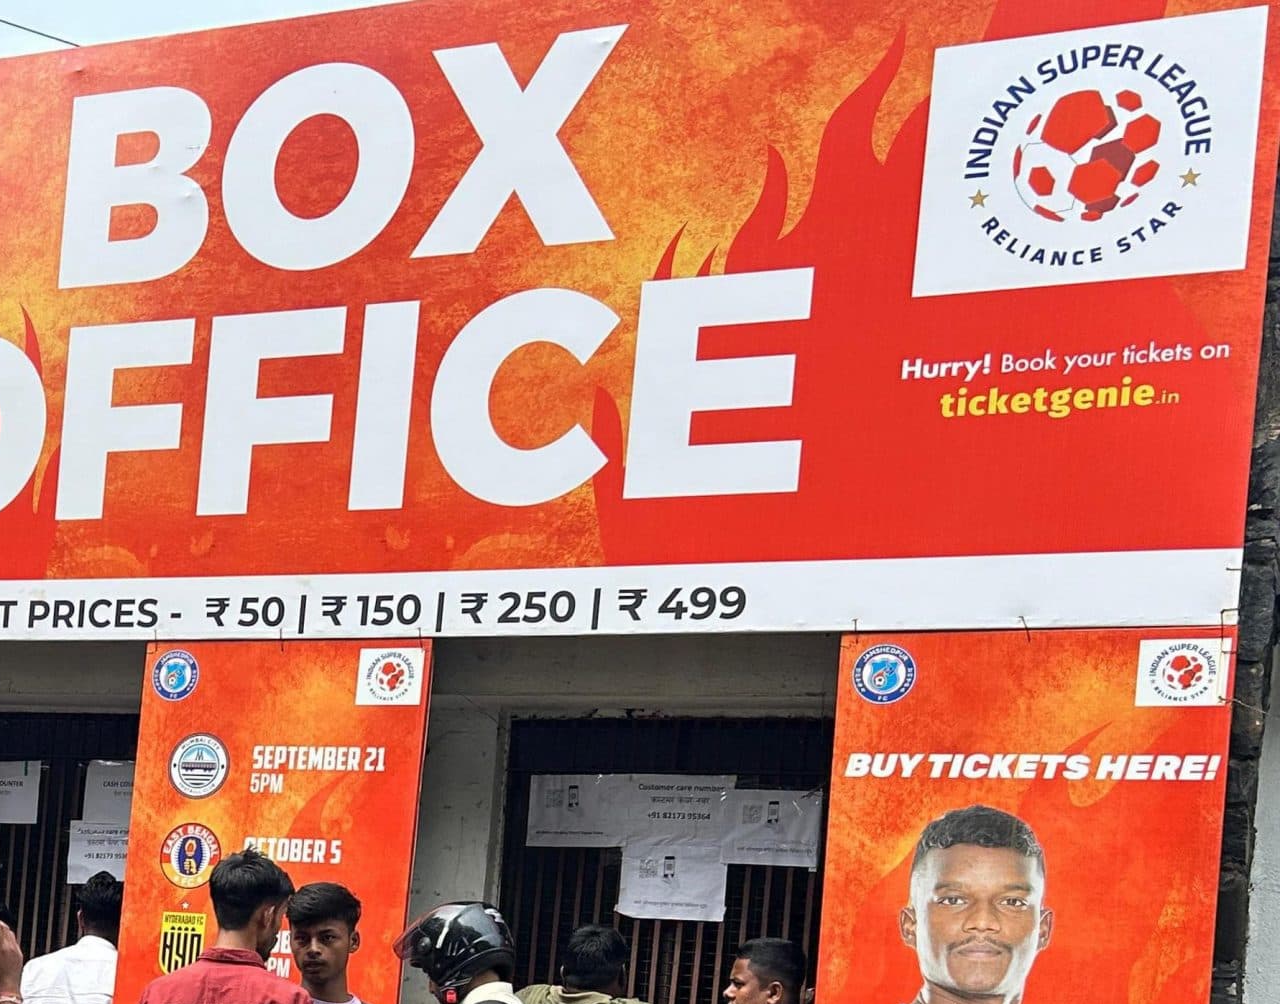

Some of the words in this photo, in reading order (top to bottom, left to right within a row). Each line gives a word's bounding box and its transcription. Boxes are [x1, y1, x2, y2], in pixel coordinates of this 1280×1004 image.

[964, 76, 1036, 179] INDIAN
[1036, 44, 1144, 85] SUPER
[1144, 54, 1211, 156] LEAGUE
[58, 24, 630, 290] BOX
[981, 216, 1102, 266] RELIANCE
[1117, 201, 1183, 253] STAR
[901, 354, 991, 381] Hurry!
[1001, 349, 1056, 373] Book
[1063, 351, 1116, 374] your
[1122, 341, 1192, 364] tickets
[1200, 343, 1230, 359] on
[939, 376, 1180, 419] ticketgenie.in
[27, 598, 159, 629] PRICES
[237, 596, 285, 627] 50
[356, 593, 421, 626] 150
[497, 591, 576, 624] 250
[657, 586, 747, 620] 499
[862, 646, 909, 663] JAMSHEDPUR
[1149, 649, 1169, 677] INDIAN
[1168, 643, 1199, 653] SUPER
[1198, 647, 1217, 676] LEAGUE
[252, 745, 361, 772] SEPTEMBER
[363, 746, 386, 772] 21
[844, 753, 926, 778] BUY
[927, 753, 1090, 781] TICKETS
[1095, 754, 1222, 781] HERE!
[249, 772, 284, 794] 5PM
[162, 826, 184, 855] EAST
[187, 825, 219, 859] BENGAL
[329, 839, 342, 865] 5
